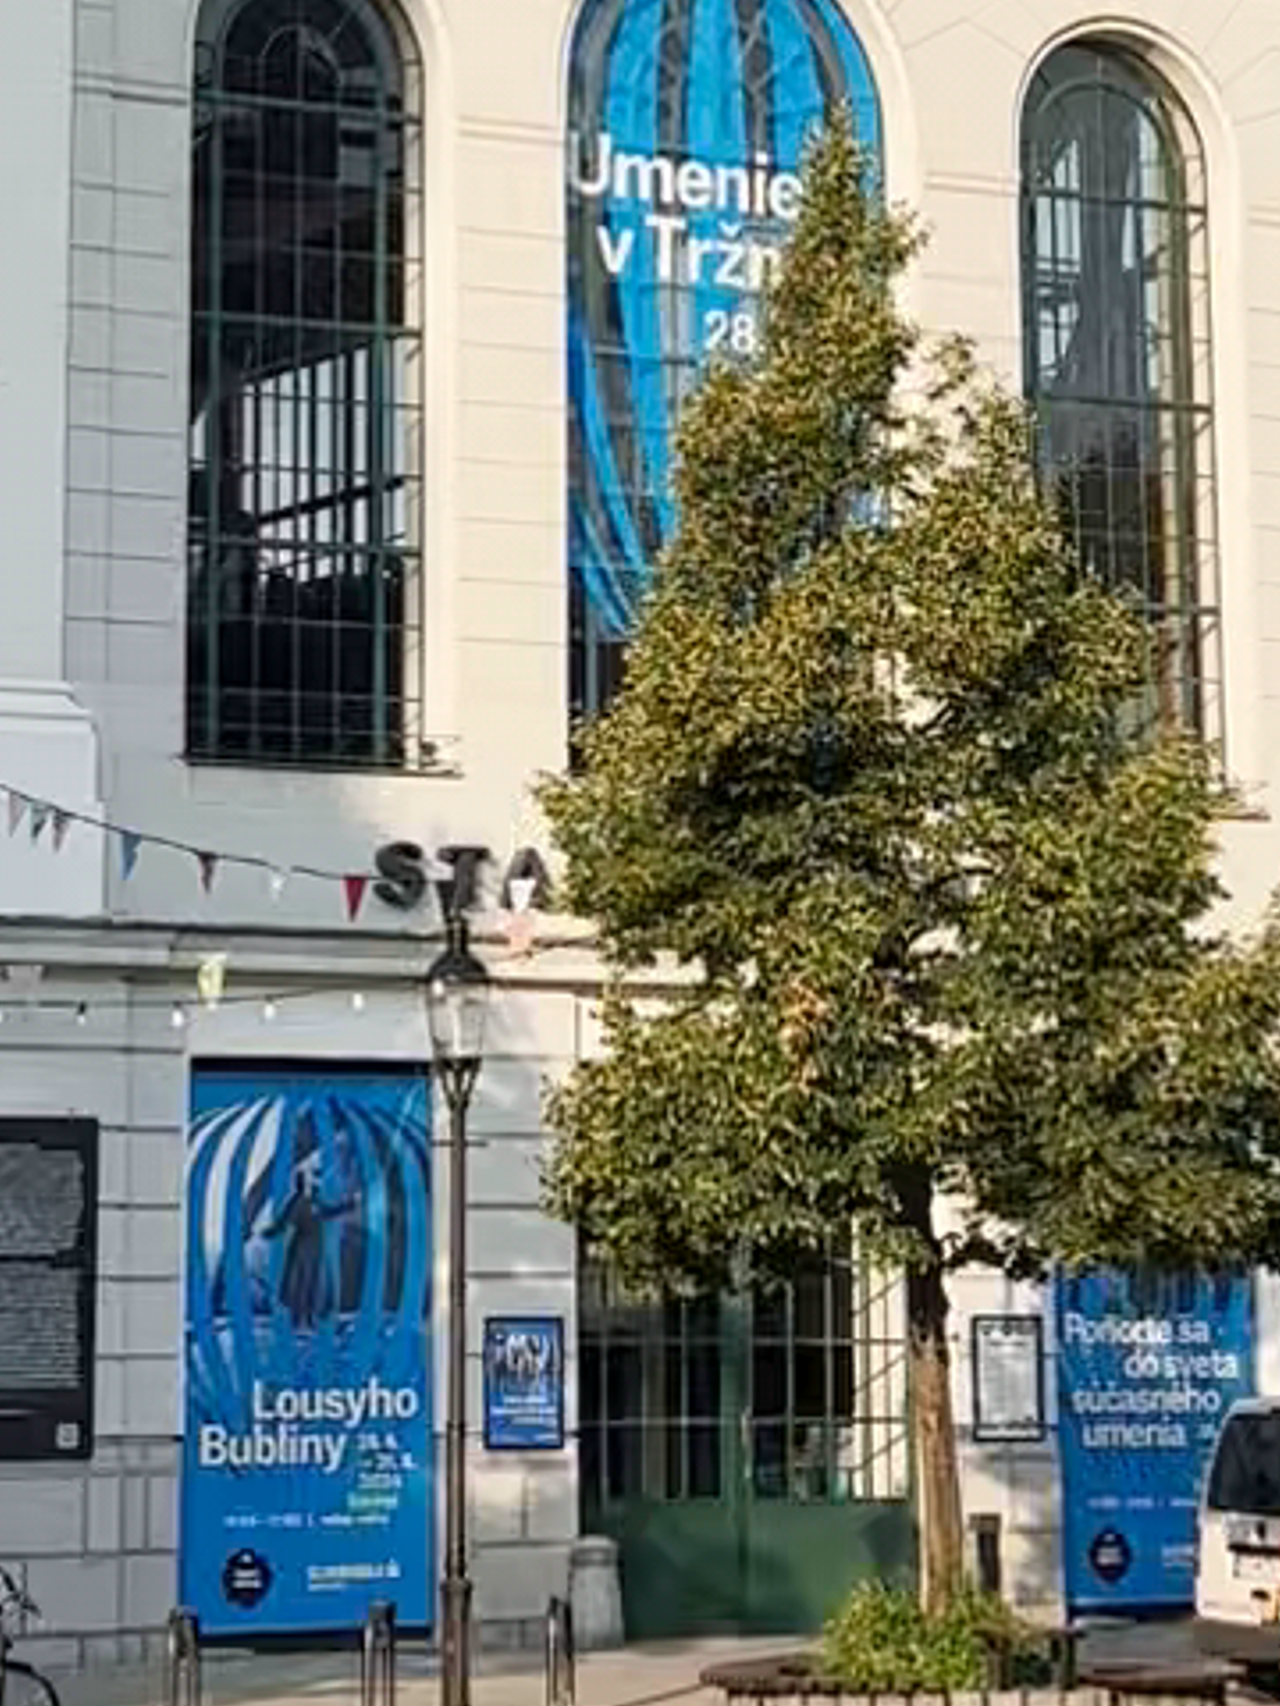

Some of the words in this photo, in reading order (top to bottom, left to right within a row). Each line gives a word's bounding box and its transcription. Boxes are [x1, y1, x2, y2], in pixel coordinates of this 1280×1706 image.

[568, 129, 804, 220] Umenie
[596, 225, 634, 275] v
[644, 214, 784, 289] Tržn
[372, 841, 556, 912] STA
[1178, 1319, 1209, 1343] sa
[1123, 1349, 1160, 1378] do
[1164, 1349, 1238, 1378] sveta
[253, 1376, 419, 1428] Lousyho
[198, 1424, 349, 1475] Bubliny
[1082, 1415, 1186, 1448] umenia
